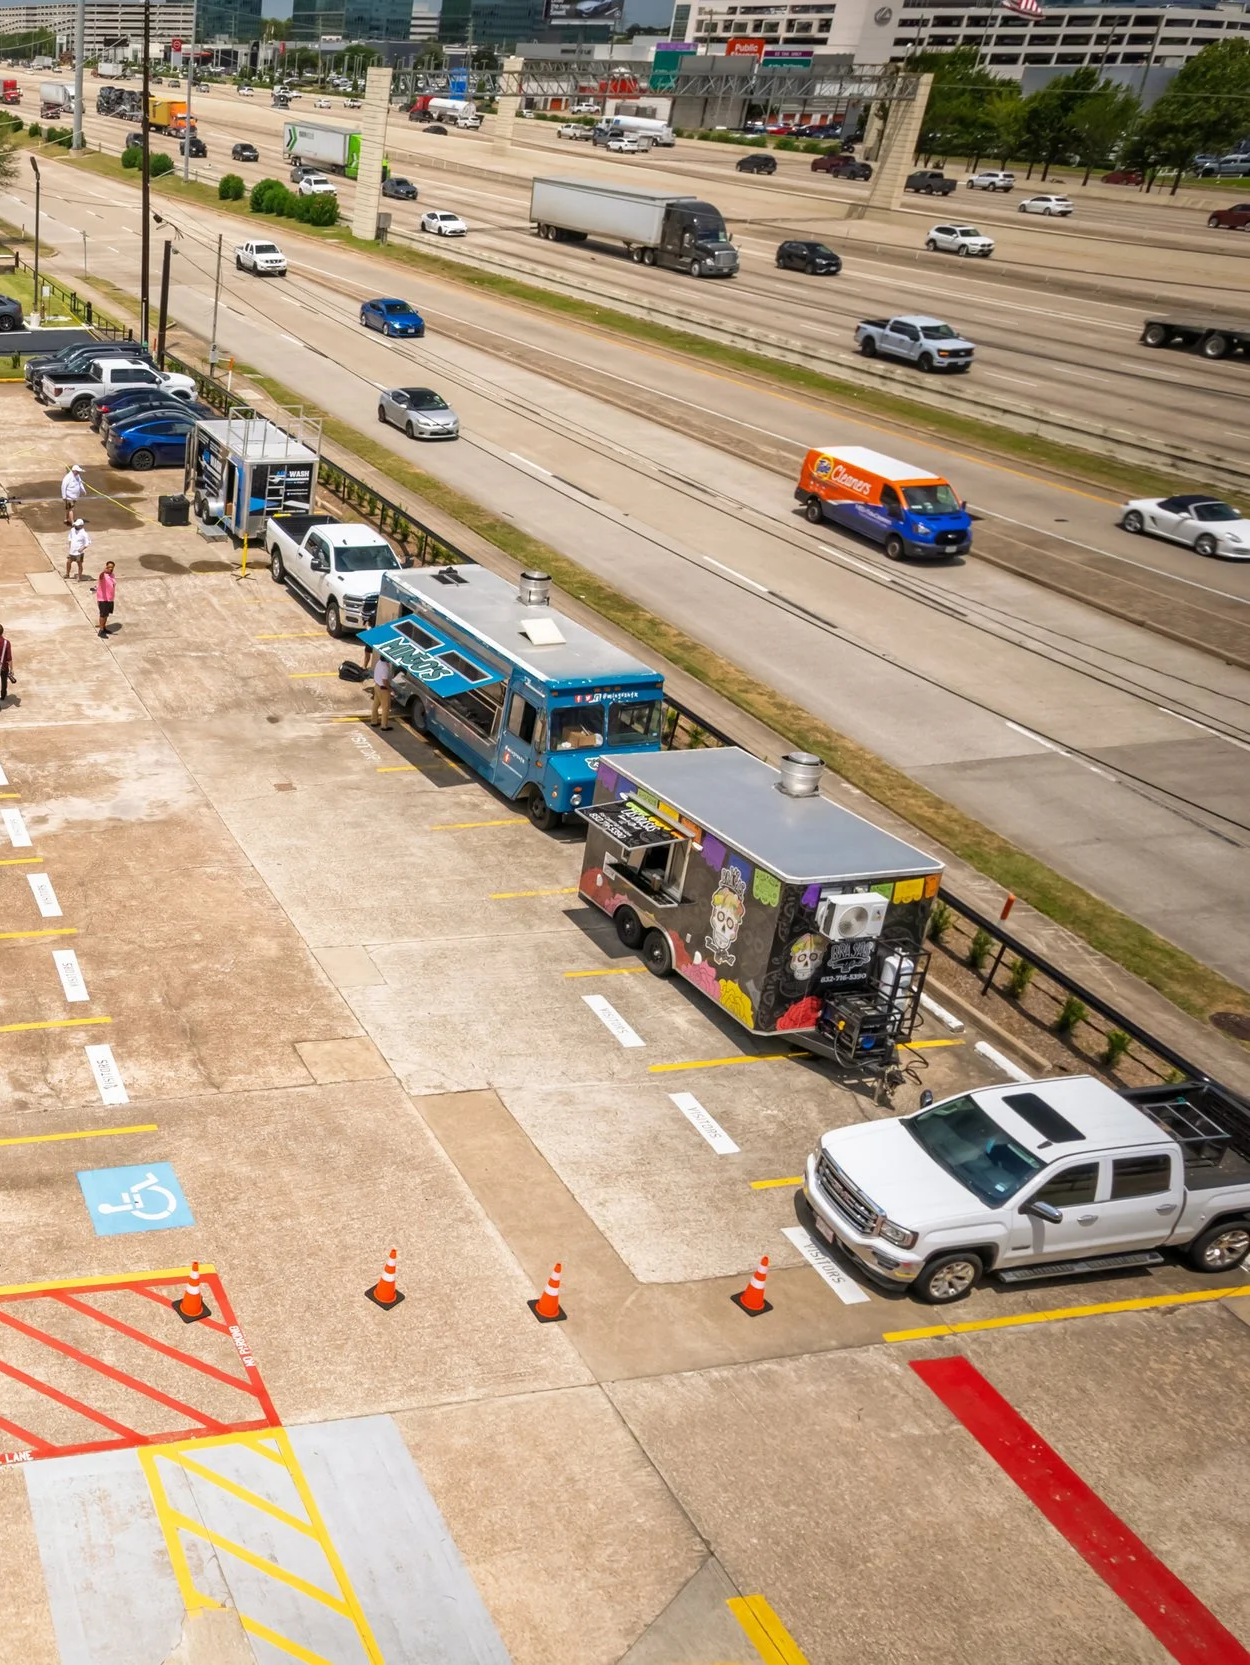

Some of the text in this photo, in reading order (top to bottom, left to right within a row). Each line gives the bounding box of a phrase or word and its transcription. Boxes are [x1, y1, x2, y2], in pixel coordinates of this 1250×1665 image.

[735, 43, 758, 52] Public
[831, 465, 872, 495] Cleaners
[372, 636, 454, 682] MINGO'S
[62, 962, 80, 988] VISITORS
[600, 1007, 630, 1036] VISITORS
[96, 1058, 118, 1090] VISITORS
[688, 1106, 722, 1140] VISITORS
[804, 1242, 846, 1284] VISITORS
[228, 1325, 256, 1367] NO PARKING
[5, 1450, 34, 1464] LANE
